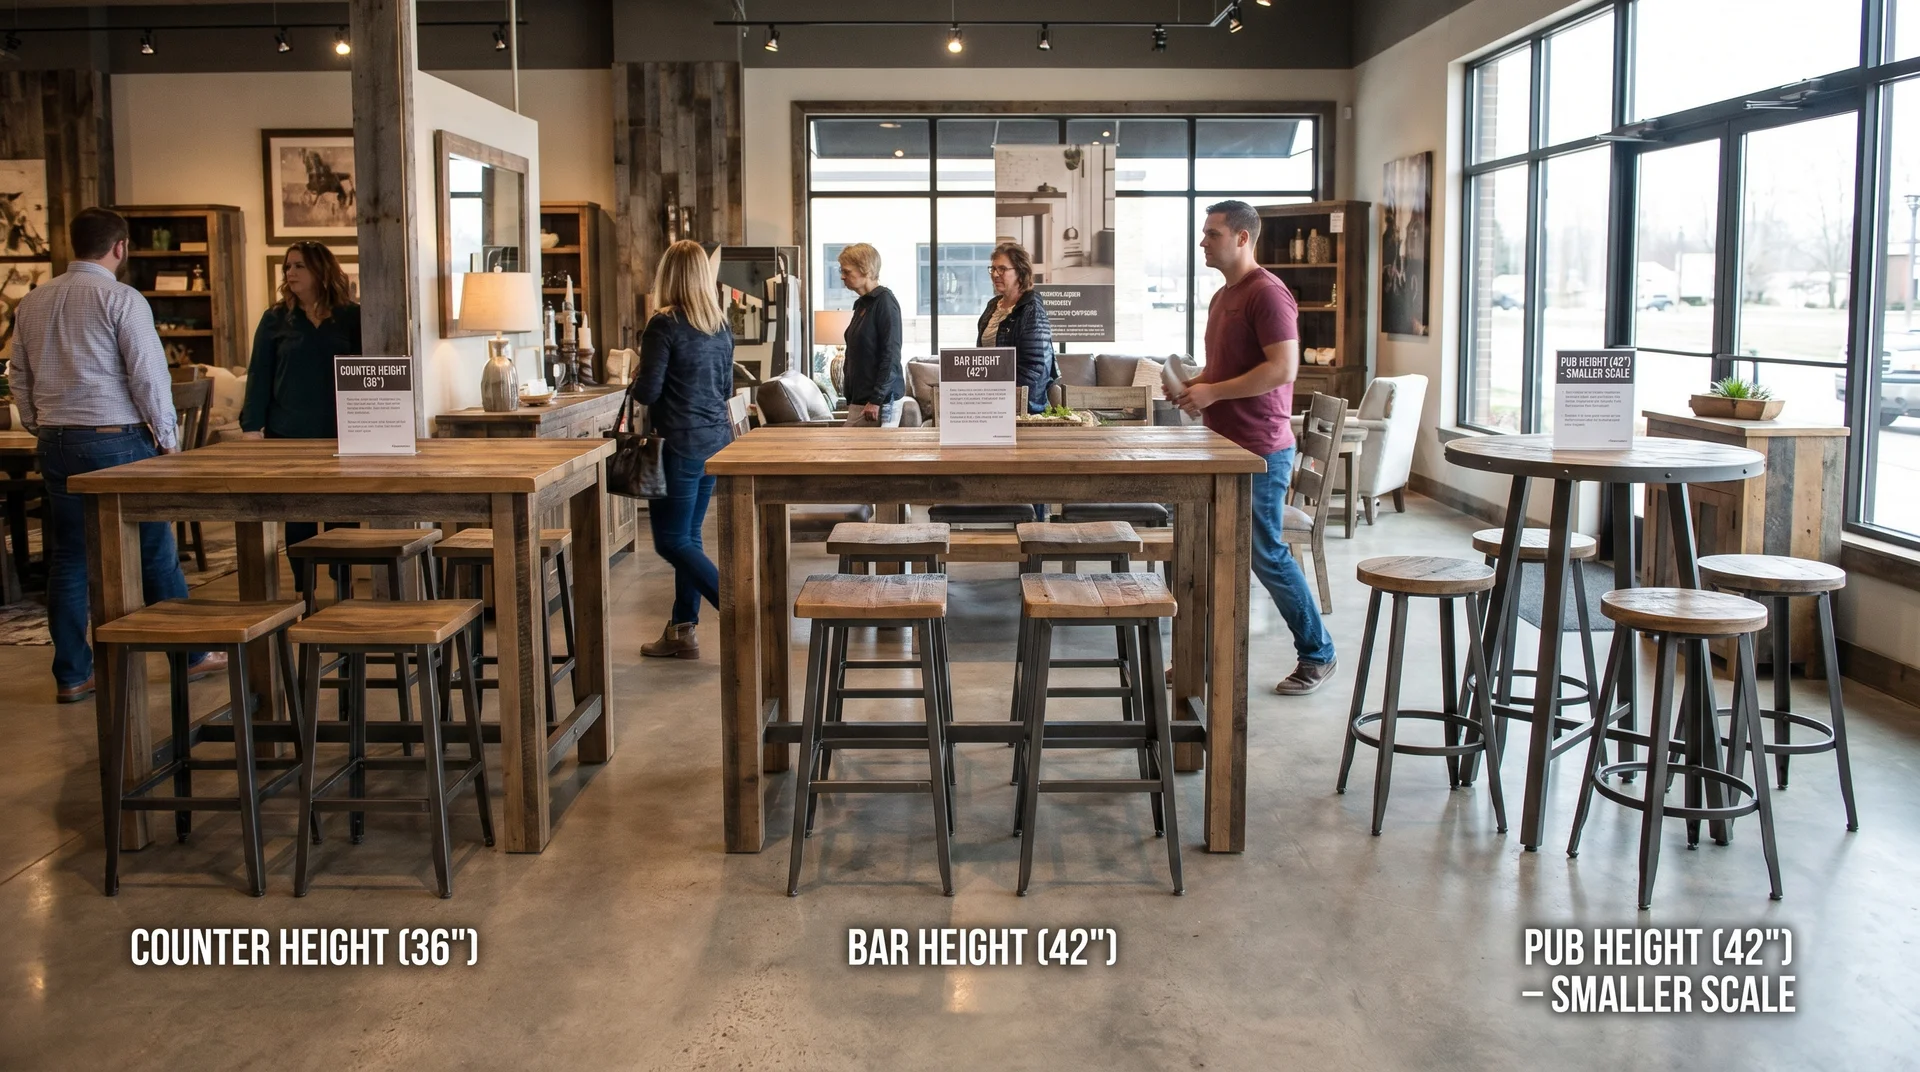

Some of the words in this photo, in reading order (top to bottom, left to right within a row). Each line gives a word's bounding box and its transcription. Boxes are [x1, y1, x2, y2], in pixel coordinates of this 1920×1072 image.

[954, 356, 970, 366] BAR
[972, 355, 1001, 366] HEIGHT
[1561, 357, 1577, 367] PUB
[1579, 356, 1608, 367] HEIGHT
[340, 365, 376, 376] COUNTER
[378, 365, 407, 376] HEIGHT
[1566, 368, 1603, 379] SMALLER
[1604, 368, 1630, 379] SCALE
